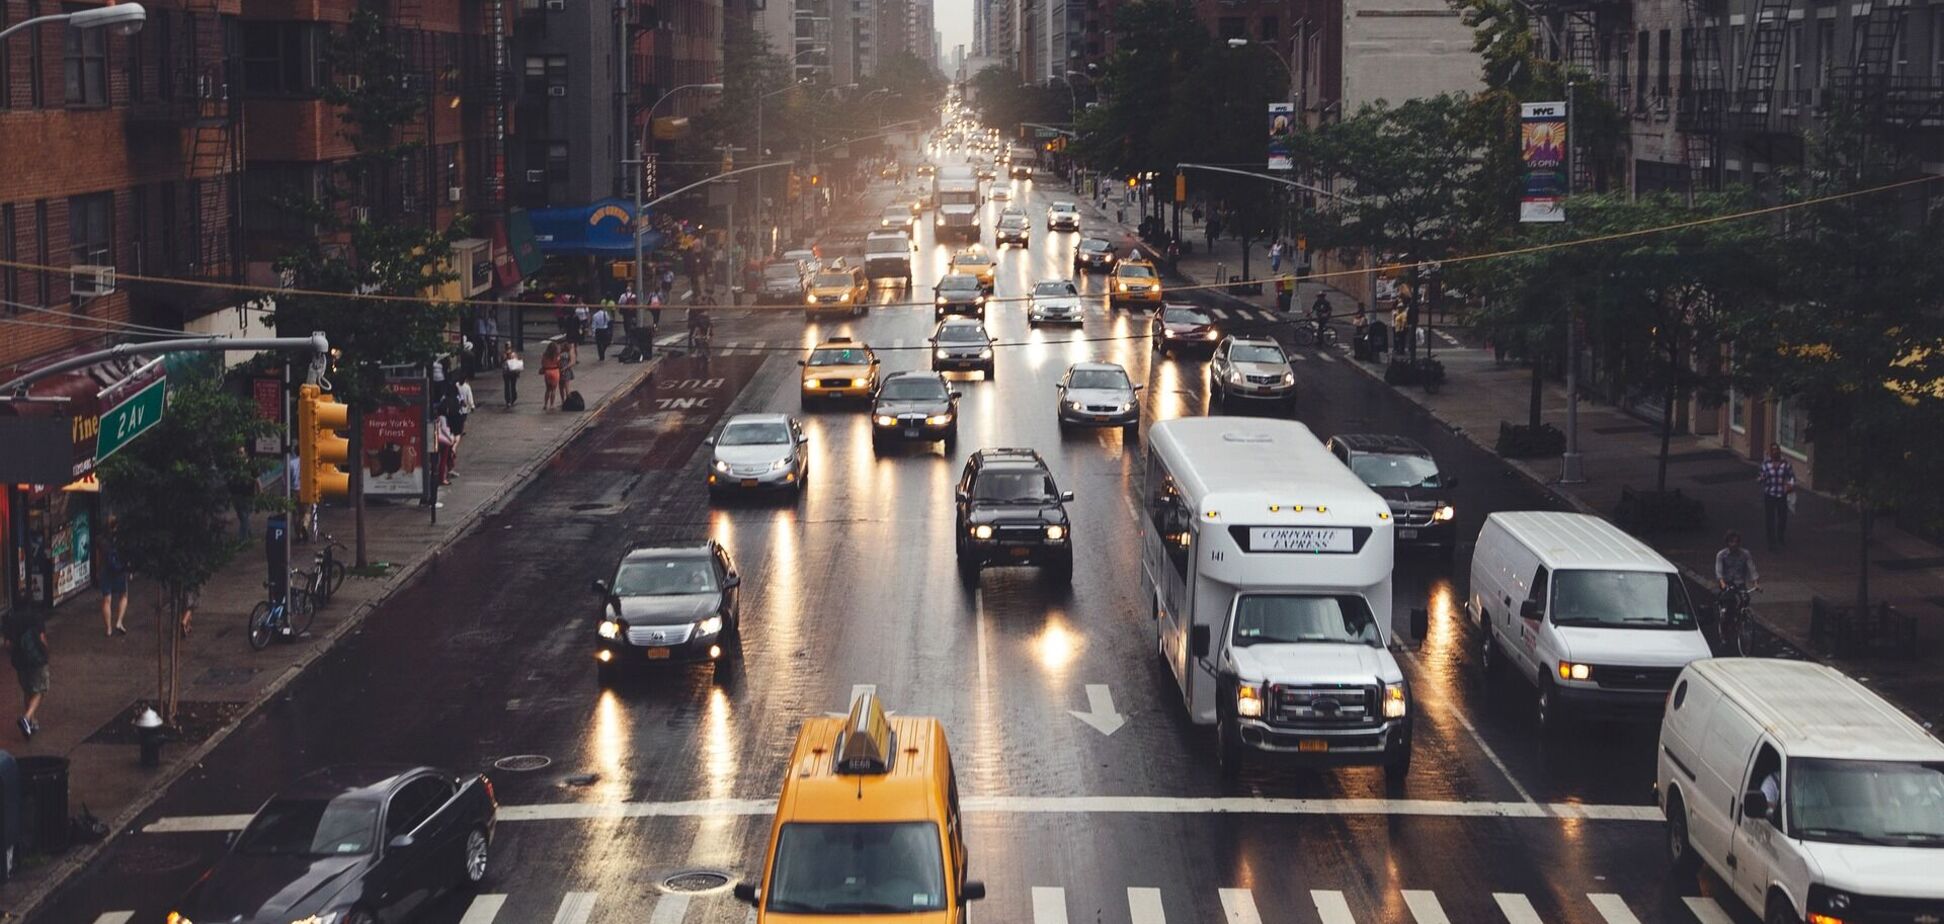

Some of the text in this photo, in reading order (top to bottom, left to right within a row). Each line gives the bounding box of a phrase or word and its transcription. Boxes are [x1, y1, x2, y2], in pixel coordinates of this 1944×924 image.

[1533, 108, 1554, 116] NYC
[1527, 160, 1537, 168] US
[117, 405, 144, 440] 2 Av
[369, 419, 416, 428] New York's
[379, 428, 405, 437] Finest
[275, 529, 283, 540] P
[1262, 531, 1336, 539] CORPORATE
[1274, 540, 1329, 549] EXPRESS
[1211, 551, 1224, 561] 141
